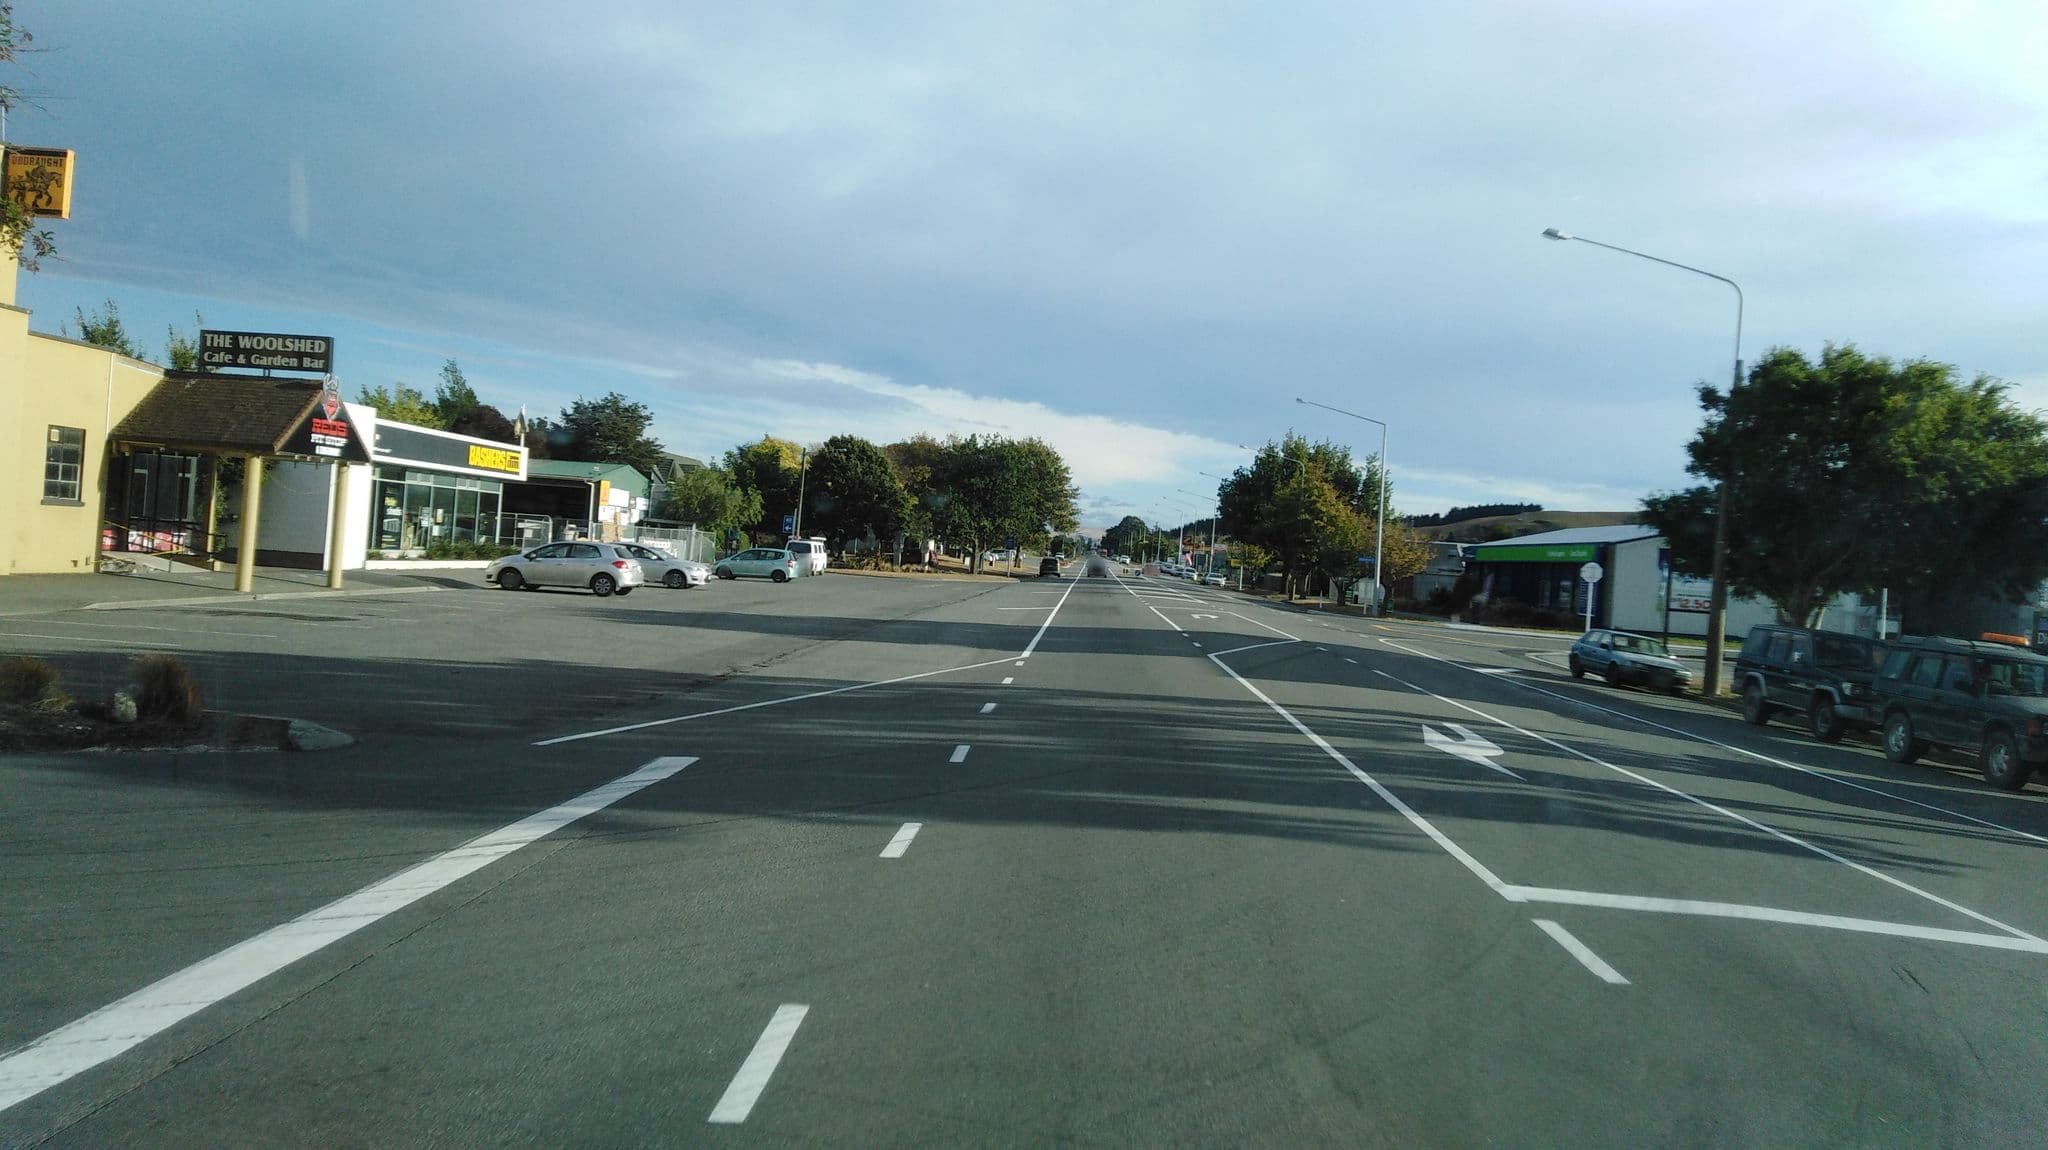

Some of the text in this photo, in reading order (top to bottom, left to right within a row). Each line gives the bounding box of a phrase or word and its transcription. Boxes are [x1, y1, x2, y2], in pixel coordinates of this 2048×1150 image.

[204, 333, 326, 354] THE WOOLSHED
[203, 351, 326, 369] Cafe & Garden Bar
[312, 418, 348, 437] REDS
